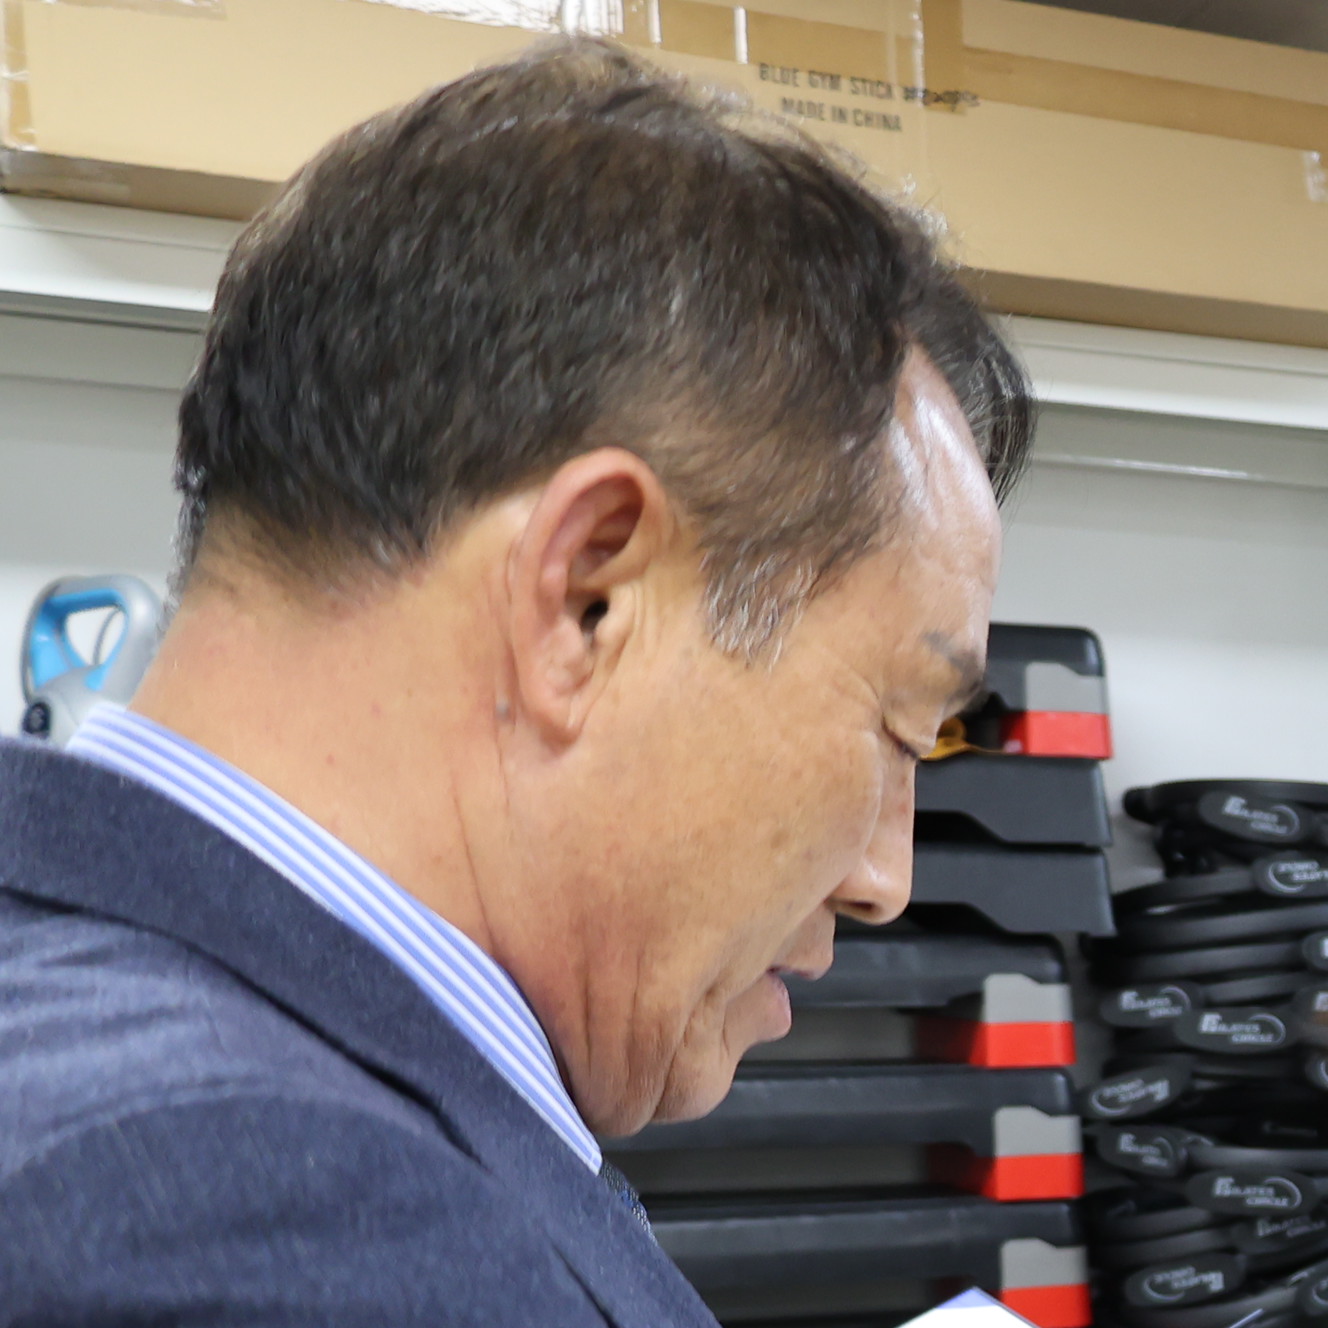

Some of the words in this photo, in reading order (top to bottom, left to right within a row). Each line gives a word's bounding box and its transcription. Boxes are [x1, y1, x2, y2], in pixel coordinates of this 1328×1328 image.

[759, 63, 799, 87] BLUE
[808, 70, 841, 90] GYM
[781, 97, 825, 120] MADE
[831, 106, 848, 124] IN
[853, 108, 902, 132] CHINA
